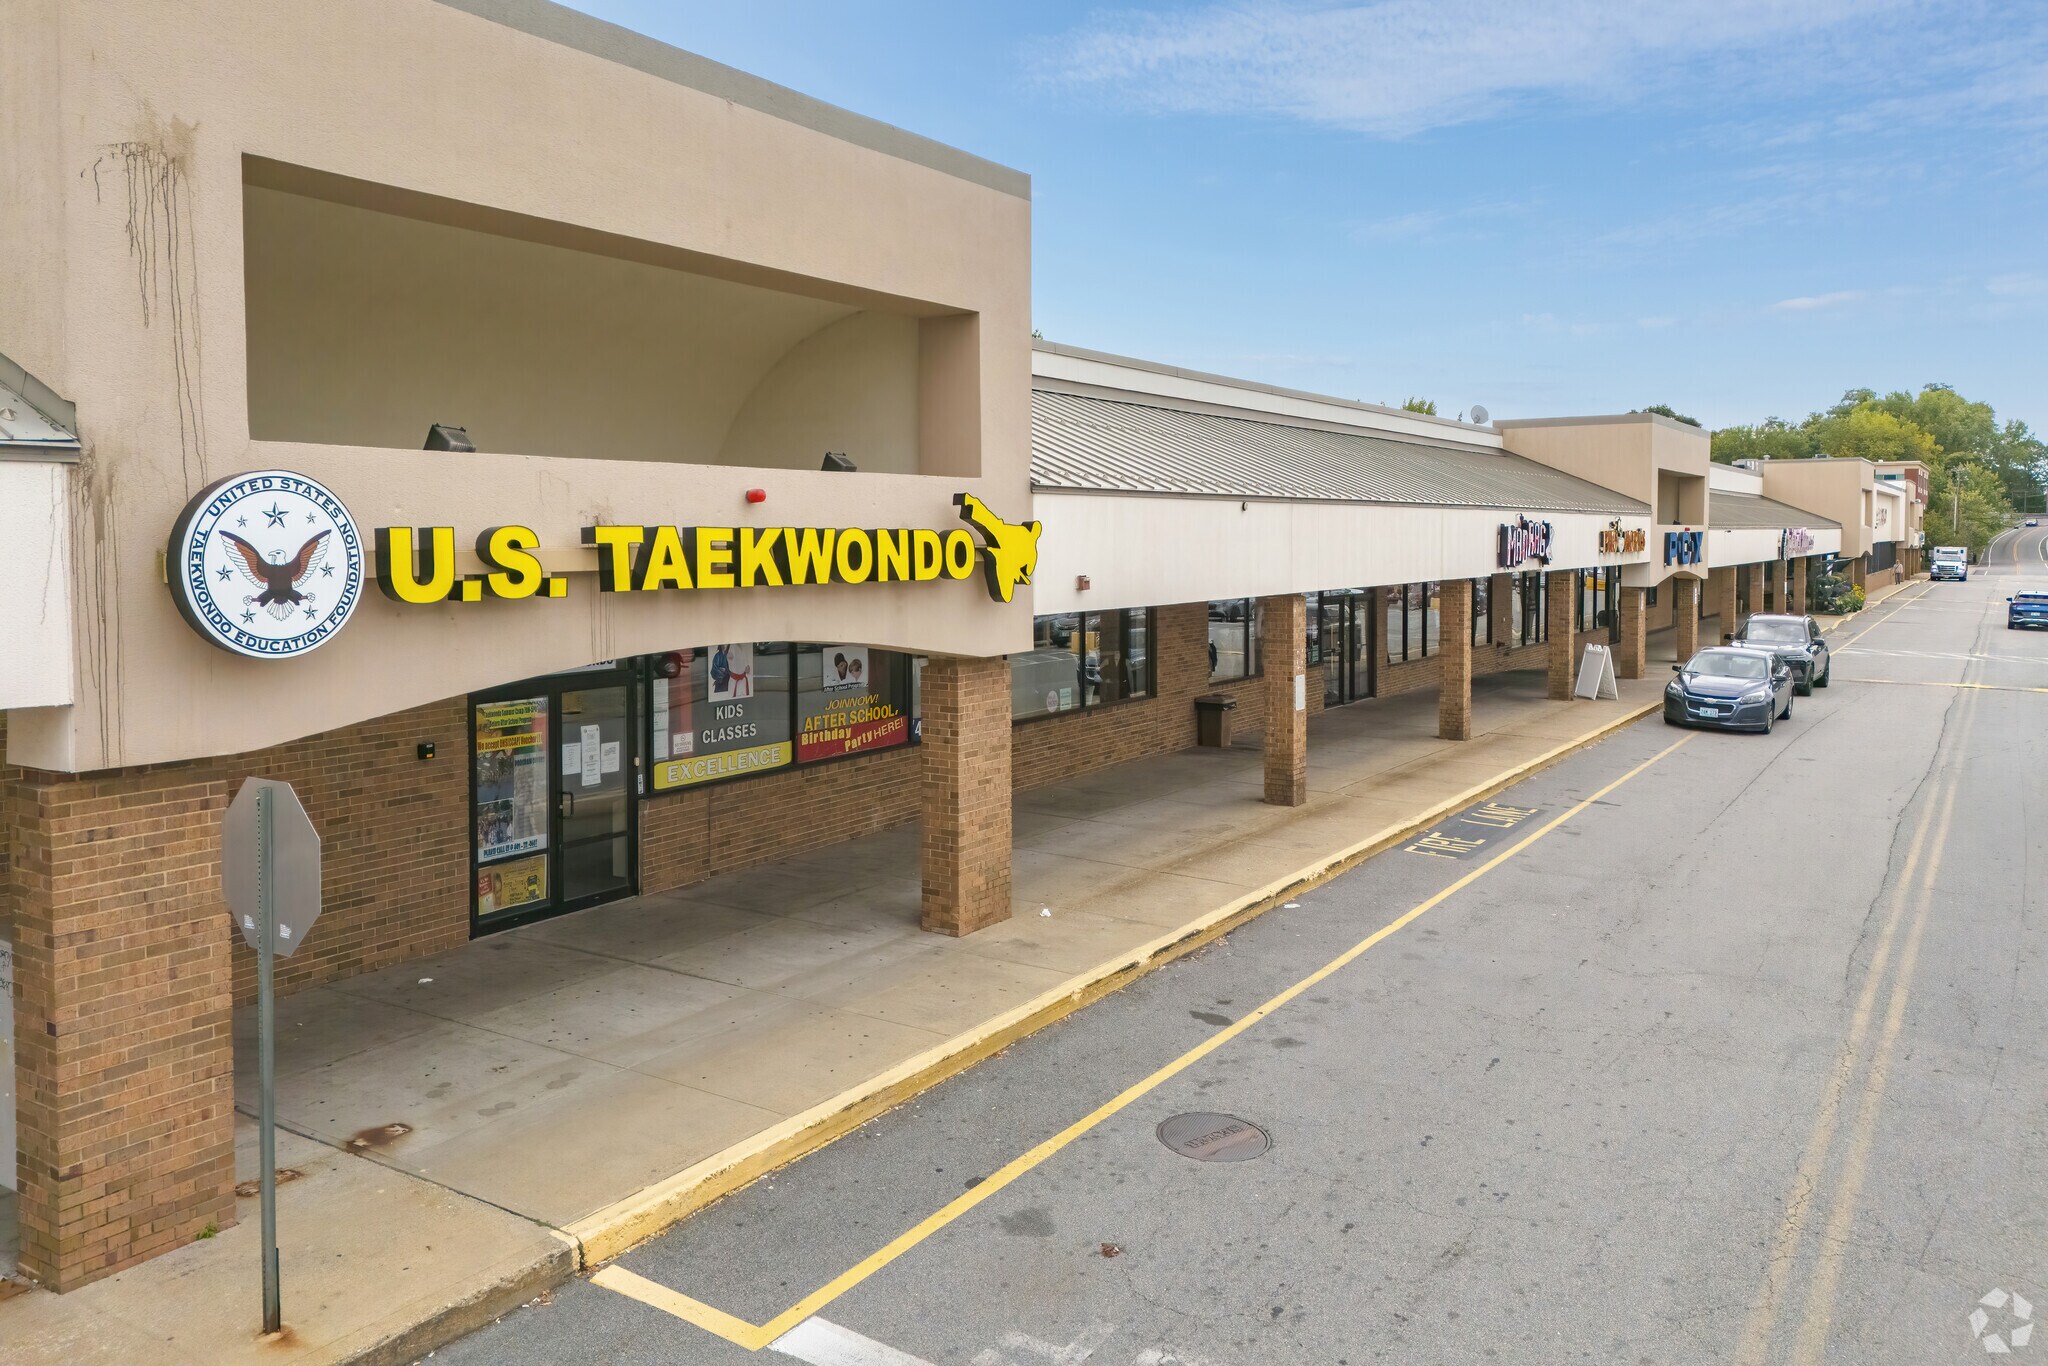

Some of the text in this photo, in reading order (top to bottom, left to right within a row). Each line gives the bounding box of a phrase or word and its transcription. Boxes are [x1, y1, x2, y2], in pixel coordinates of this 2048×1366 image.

[207, 478, 341, 519] UNITED STATES
[377, 525, 977, 604] U.S. TAEKWONDO
[189, 522, 360, 652] TAEKWONDO EDUCATION FOUNDATION
[716, 704, 743, 720] KIDS
[804, 712, 847, 732] AFTER
[702, 723, 757, 744] CLASSES
[801, 727, 852, 746] Birthday
[874, 717, 904, 739] HERE!
[844, 729, 873, 752] Party
[667, 747, 781, 783] EXCELLENCE
[1403, 802, 1539, 860] FIRE LANE
